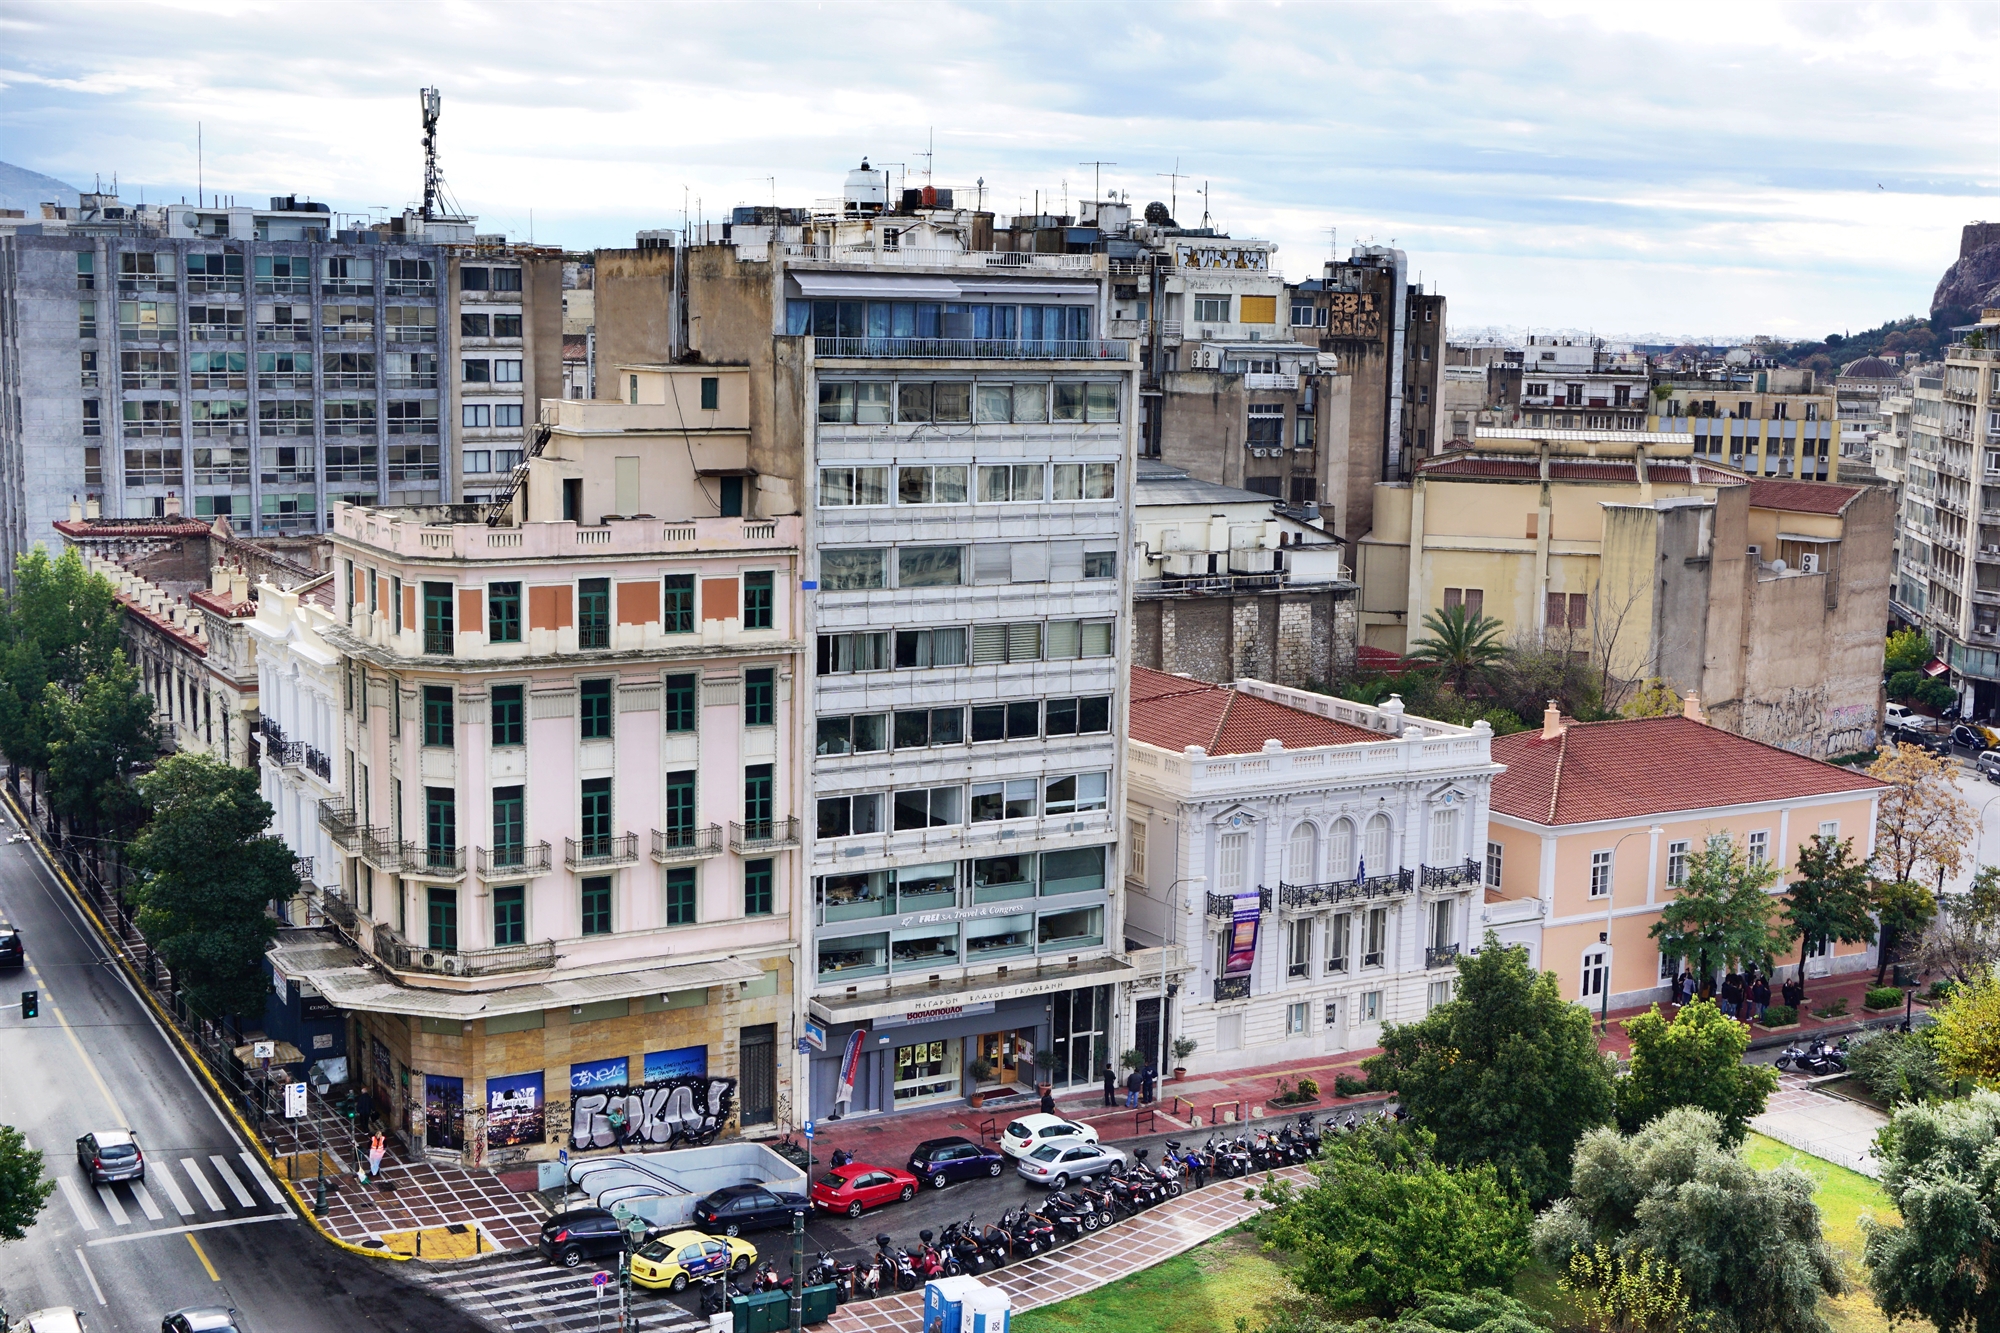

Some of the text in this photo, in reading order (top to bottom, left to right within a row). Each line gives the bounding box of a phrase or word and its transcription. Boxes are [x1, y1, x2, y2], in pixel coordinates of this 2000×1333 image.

[919, 913, 940, 924] FREI
[954, 908, 978, 919] Travel
[979, 907, 987, 916] &
[989, 904, 1024, 915] Congress
[915, 997, 958, 1009] ΜΕΓΑΡΟΝ
[1014, 982, 1064, 995] ΓΚΛΑΒΑΝΗ
[907, 1013, 963, 1025] DELICATESSEN
[806, 1122, 812, 1131] P
